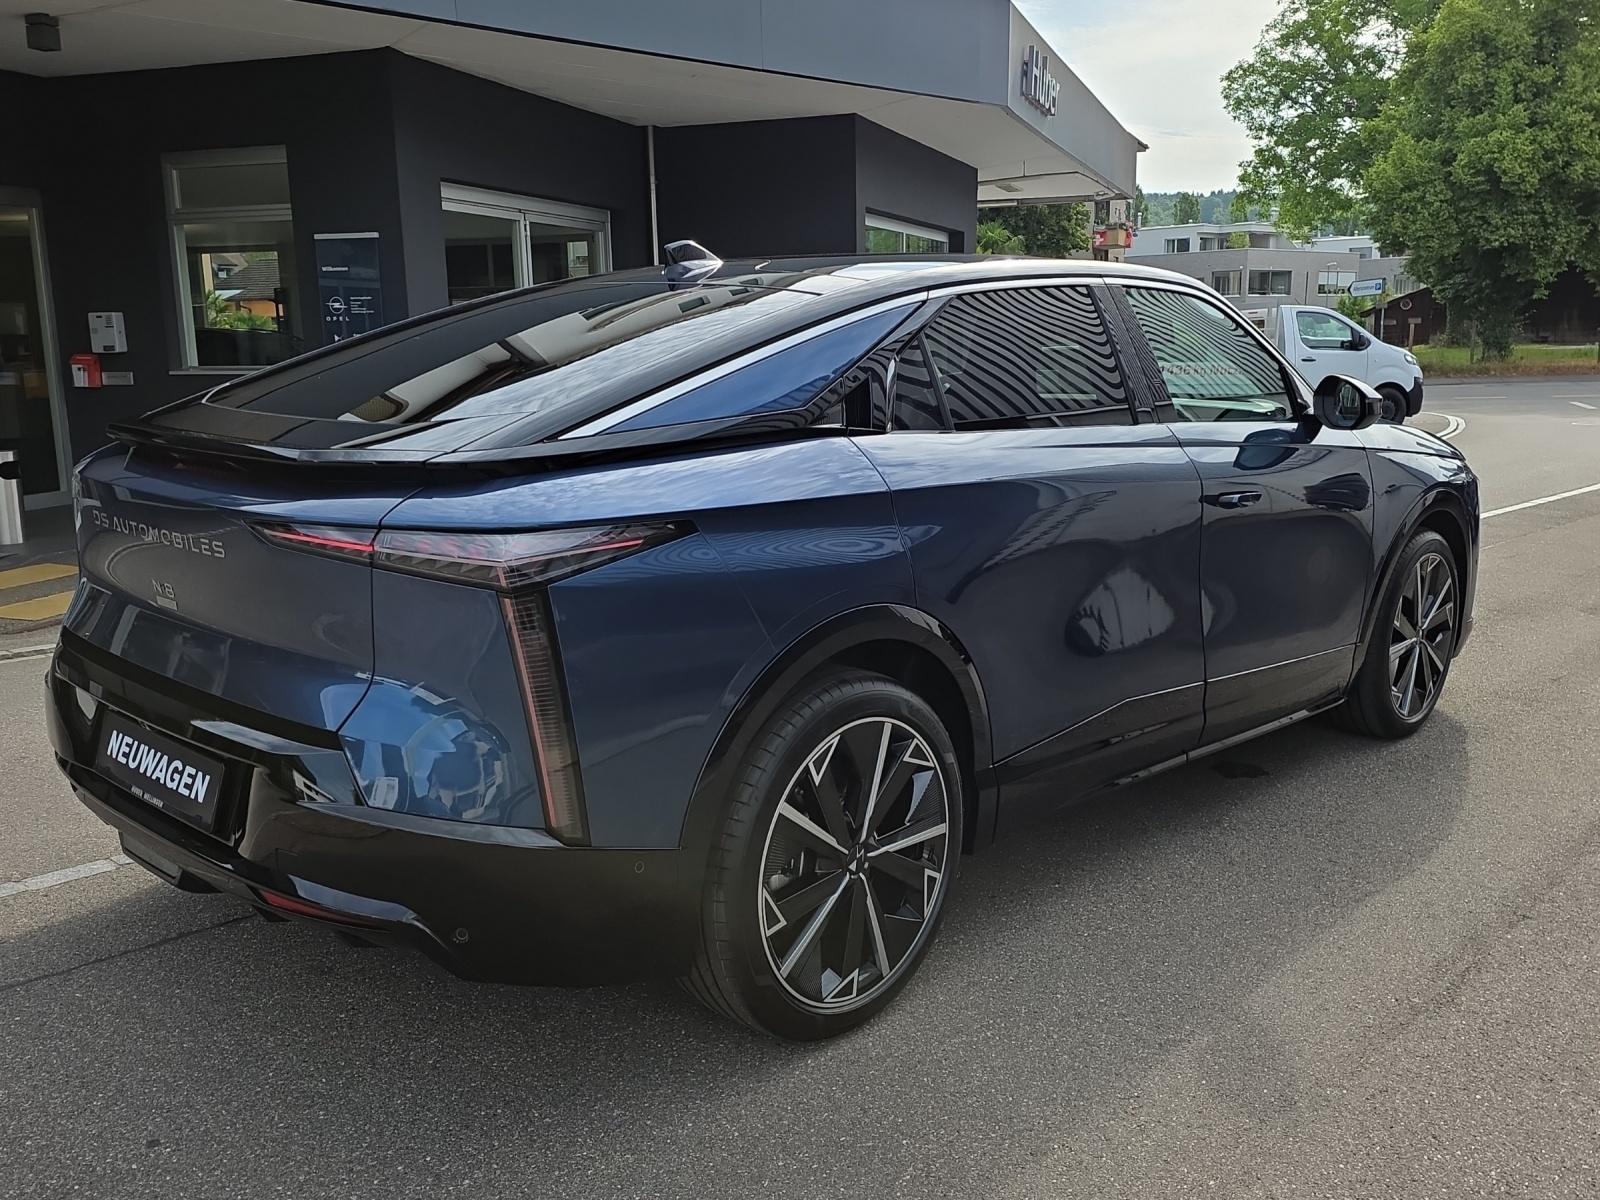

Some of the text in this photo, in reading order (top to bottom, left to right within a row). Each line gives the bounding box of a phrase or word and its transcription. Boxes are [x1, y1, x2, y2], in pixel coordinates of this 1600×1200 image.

[1028, 45, 1061, 117] Huber
[92, 510, 226, 558] DS AUTOMOBILES
[106, 729, 211, 804] NEUWAGEN
